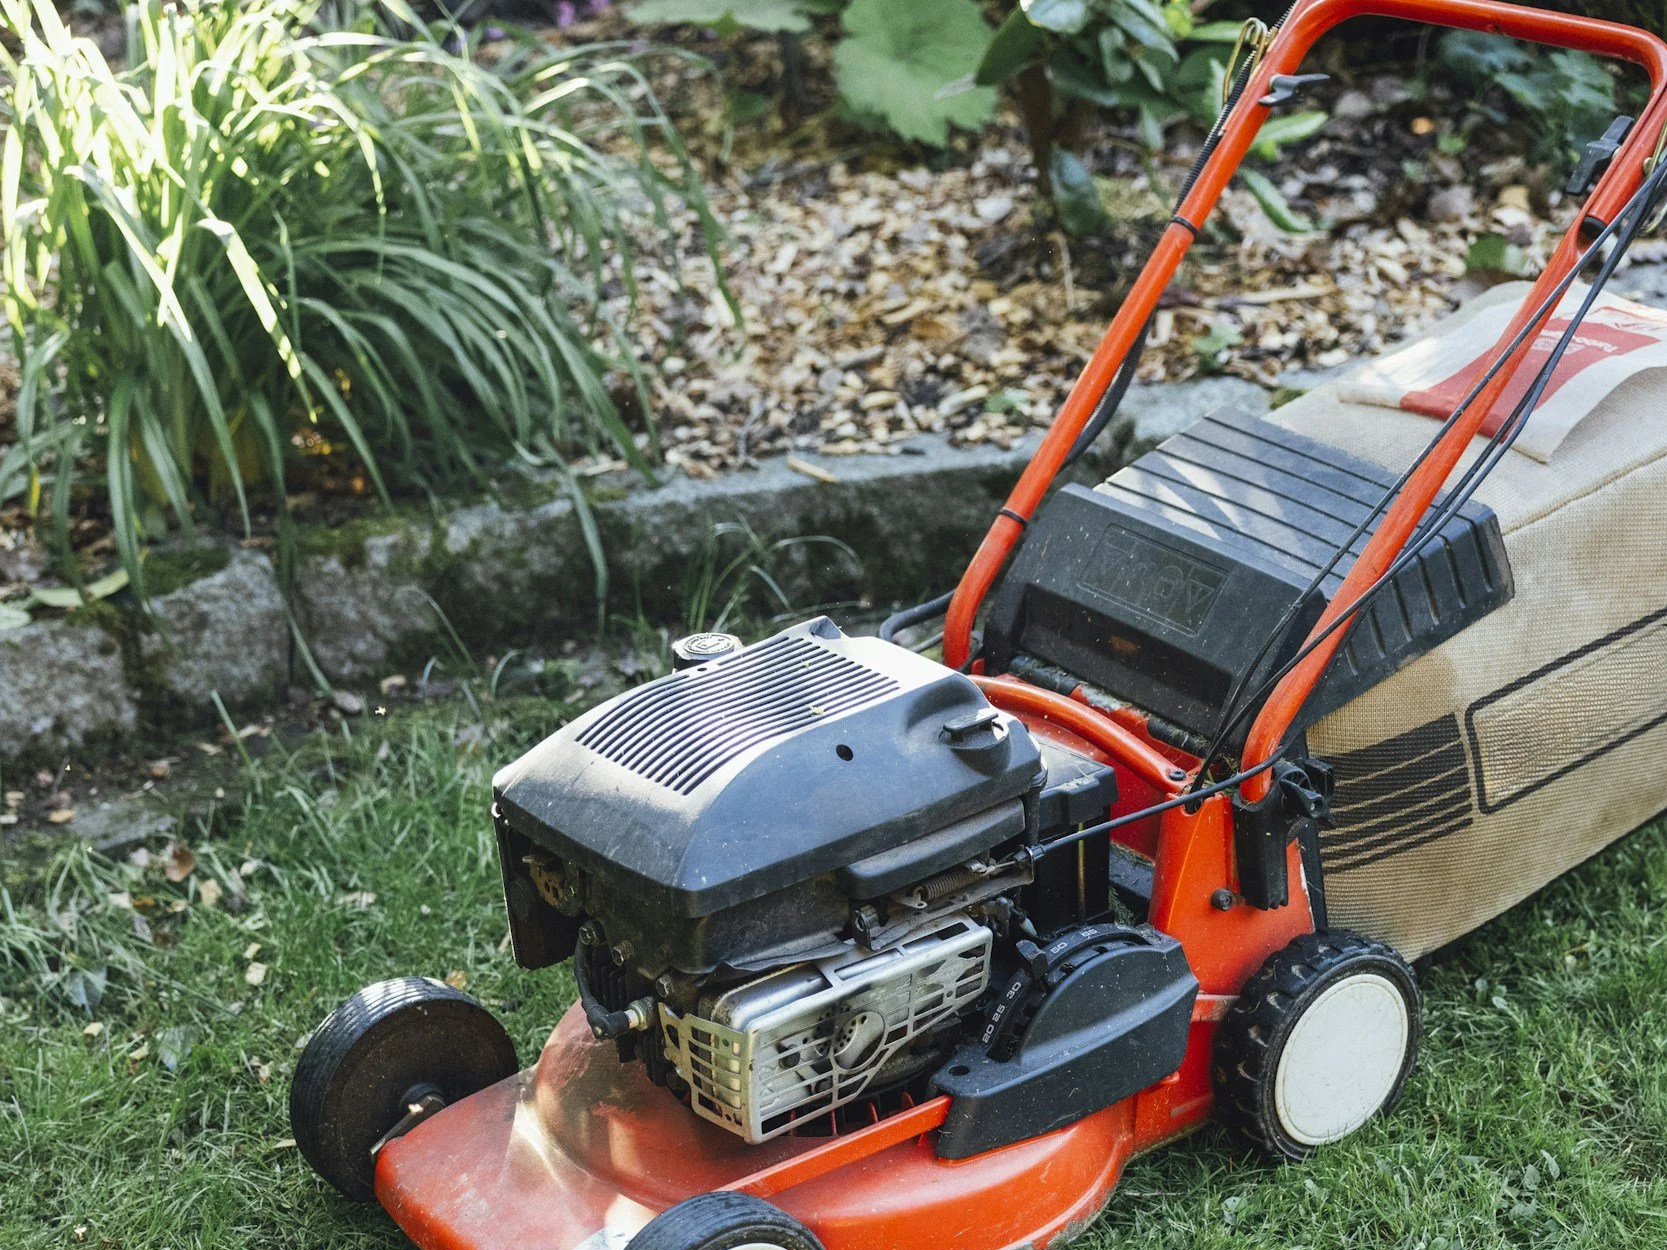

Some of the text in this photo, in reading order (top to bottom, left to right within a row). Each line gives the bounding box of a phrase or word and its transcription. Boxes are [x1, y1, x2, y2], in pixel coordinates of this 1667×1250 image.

[982, 1023, 995, 1044] 20
[992, 1004, 1006, 1023] 25
[1006, 981, 1022, 999] 30
